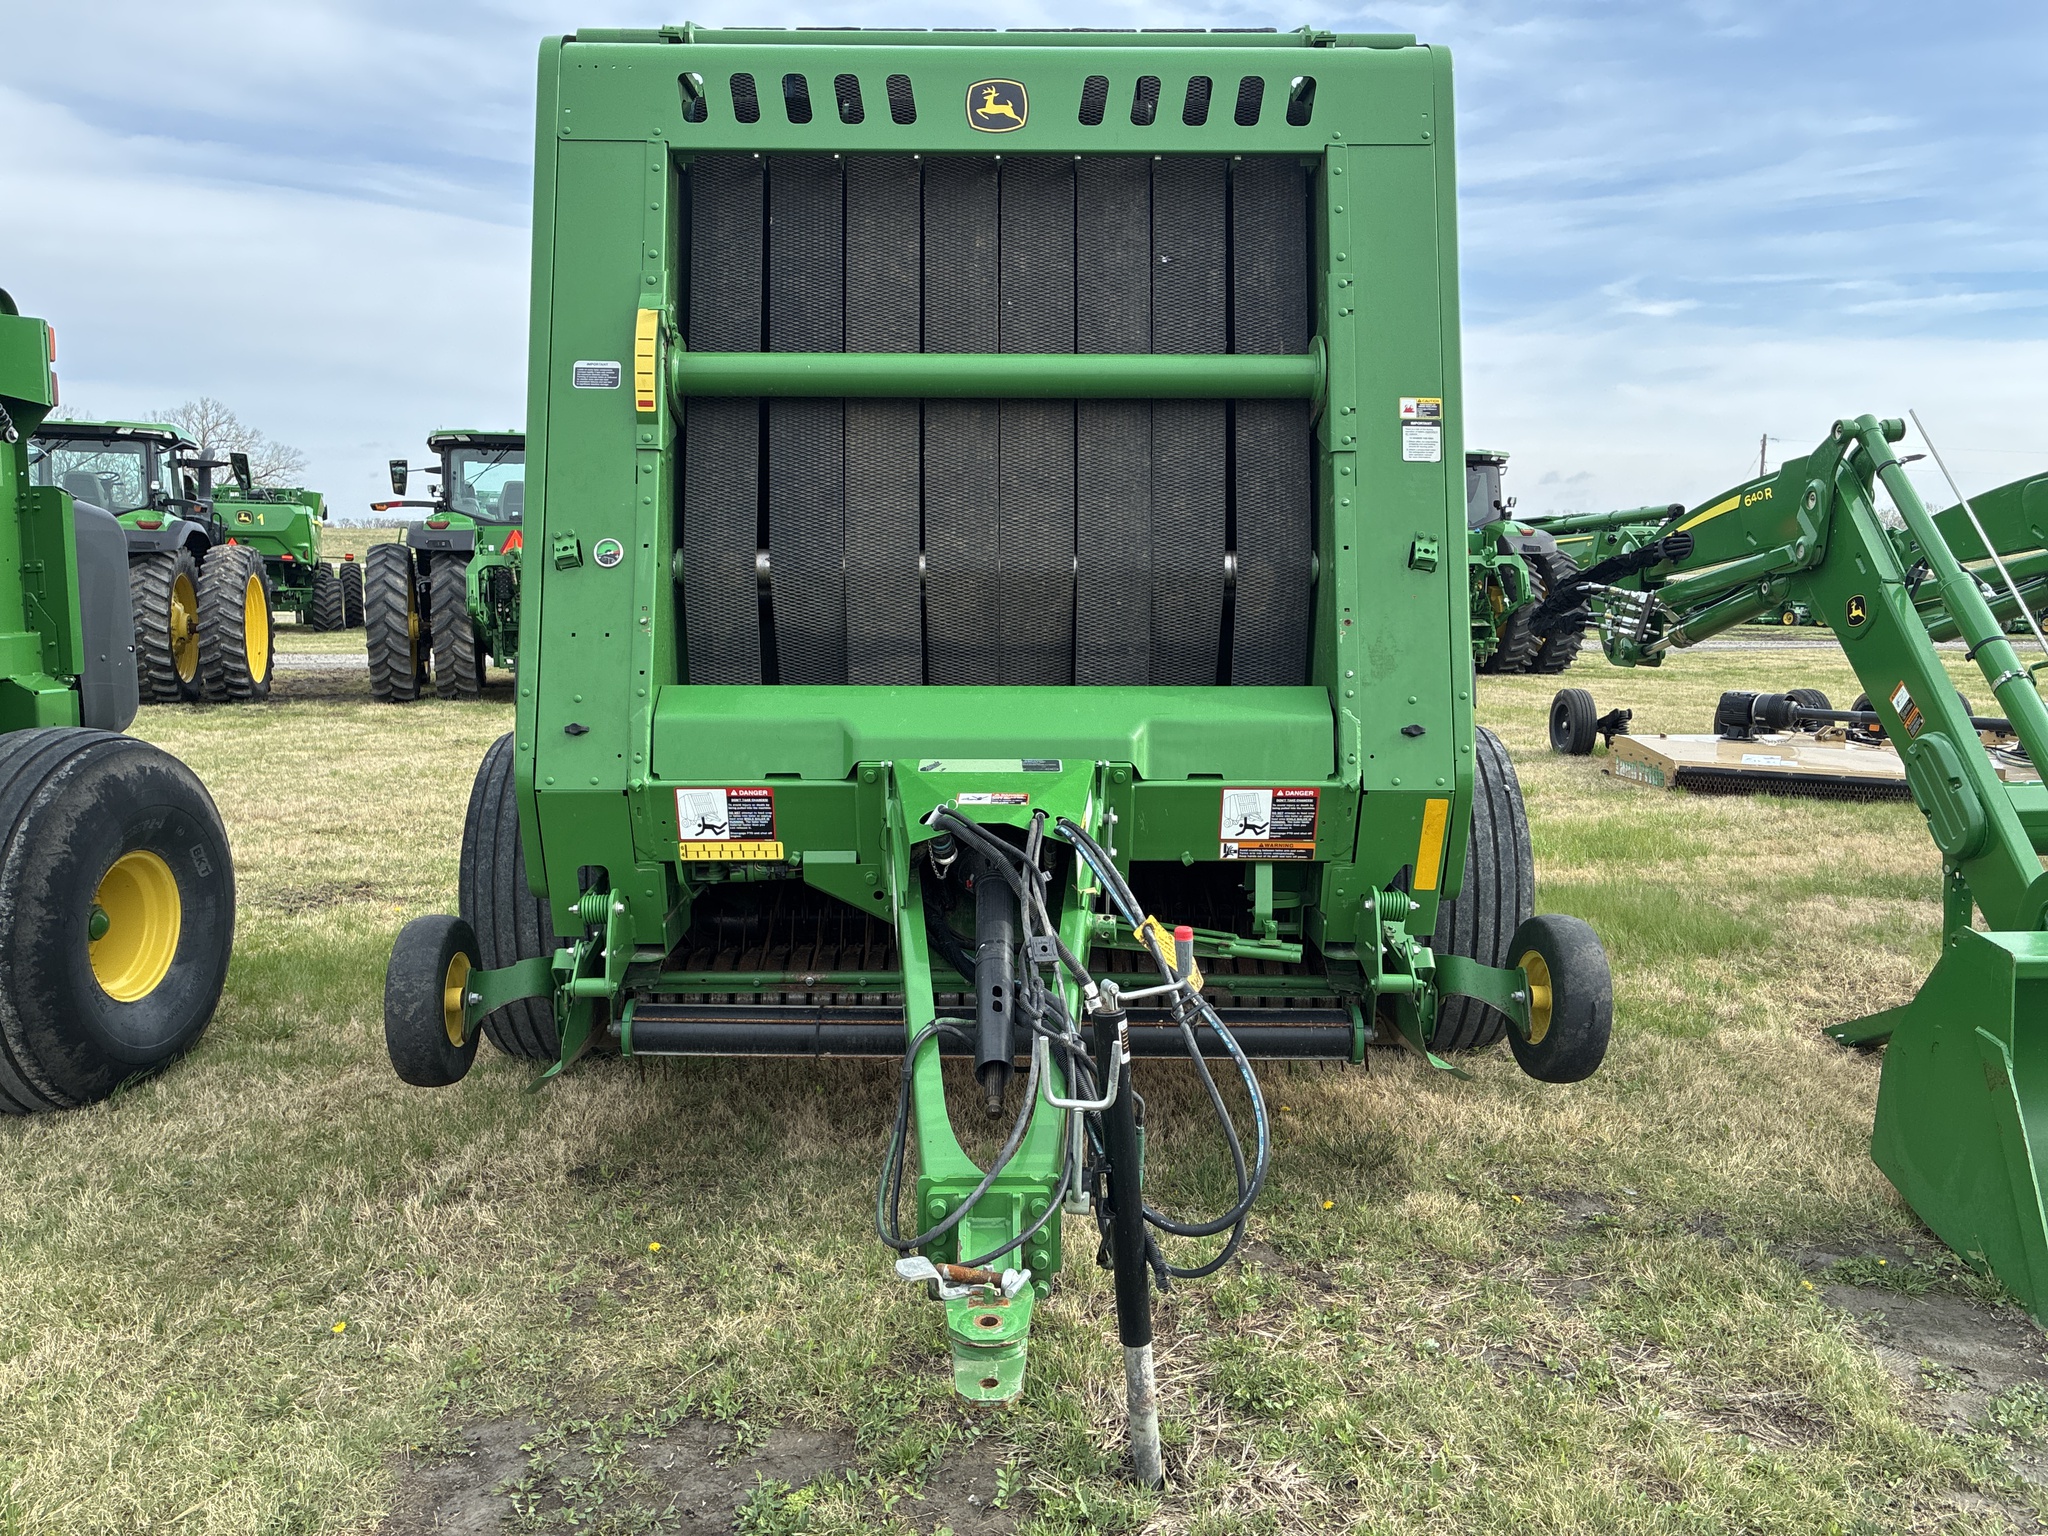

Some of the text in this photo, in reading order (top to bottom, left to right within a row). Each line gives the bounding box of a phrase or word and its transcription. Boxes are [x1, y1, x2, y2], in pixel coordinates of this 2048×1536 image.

[257, 513, 264, 526] 1
[1615, 754, 1665, 788] Land Pride
[192, 846, 211, 875] BKT
